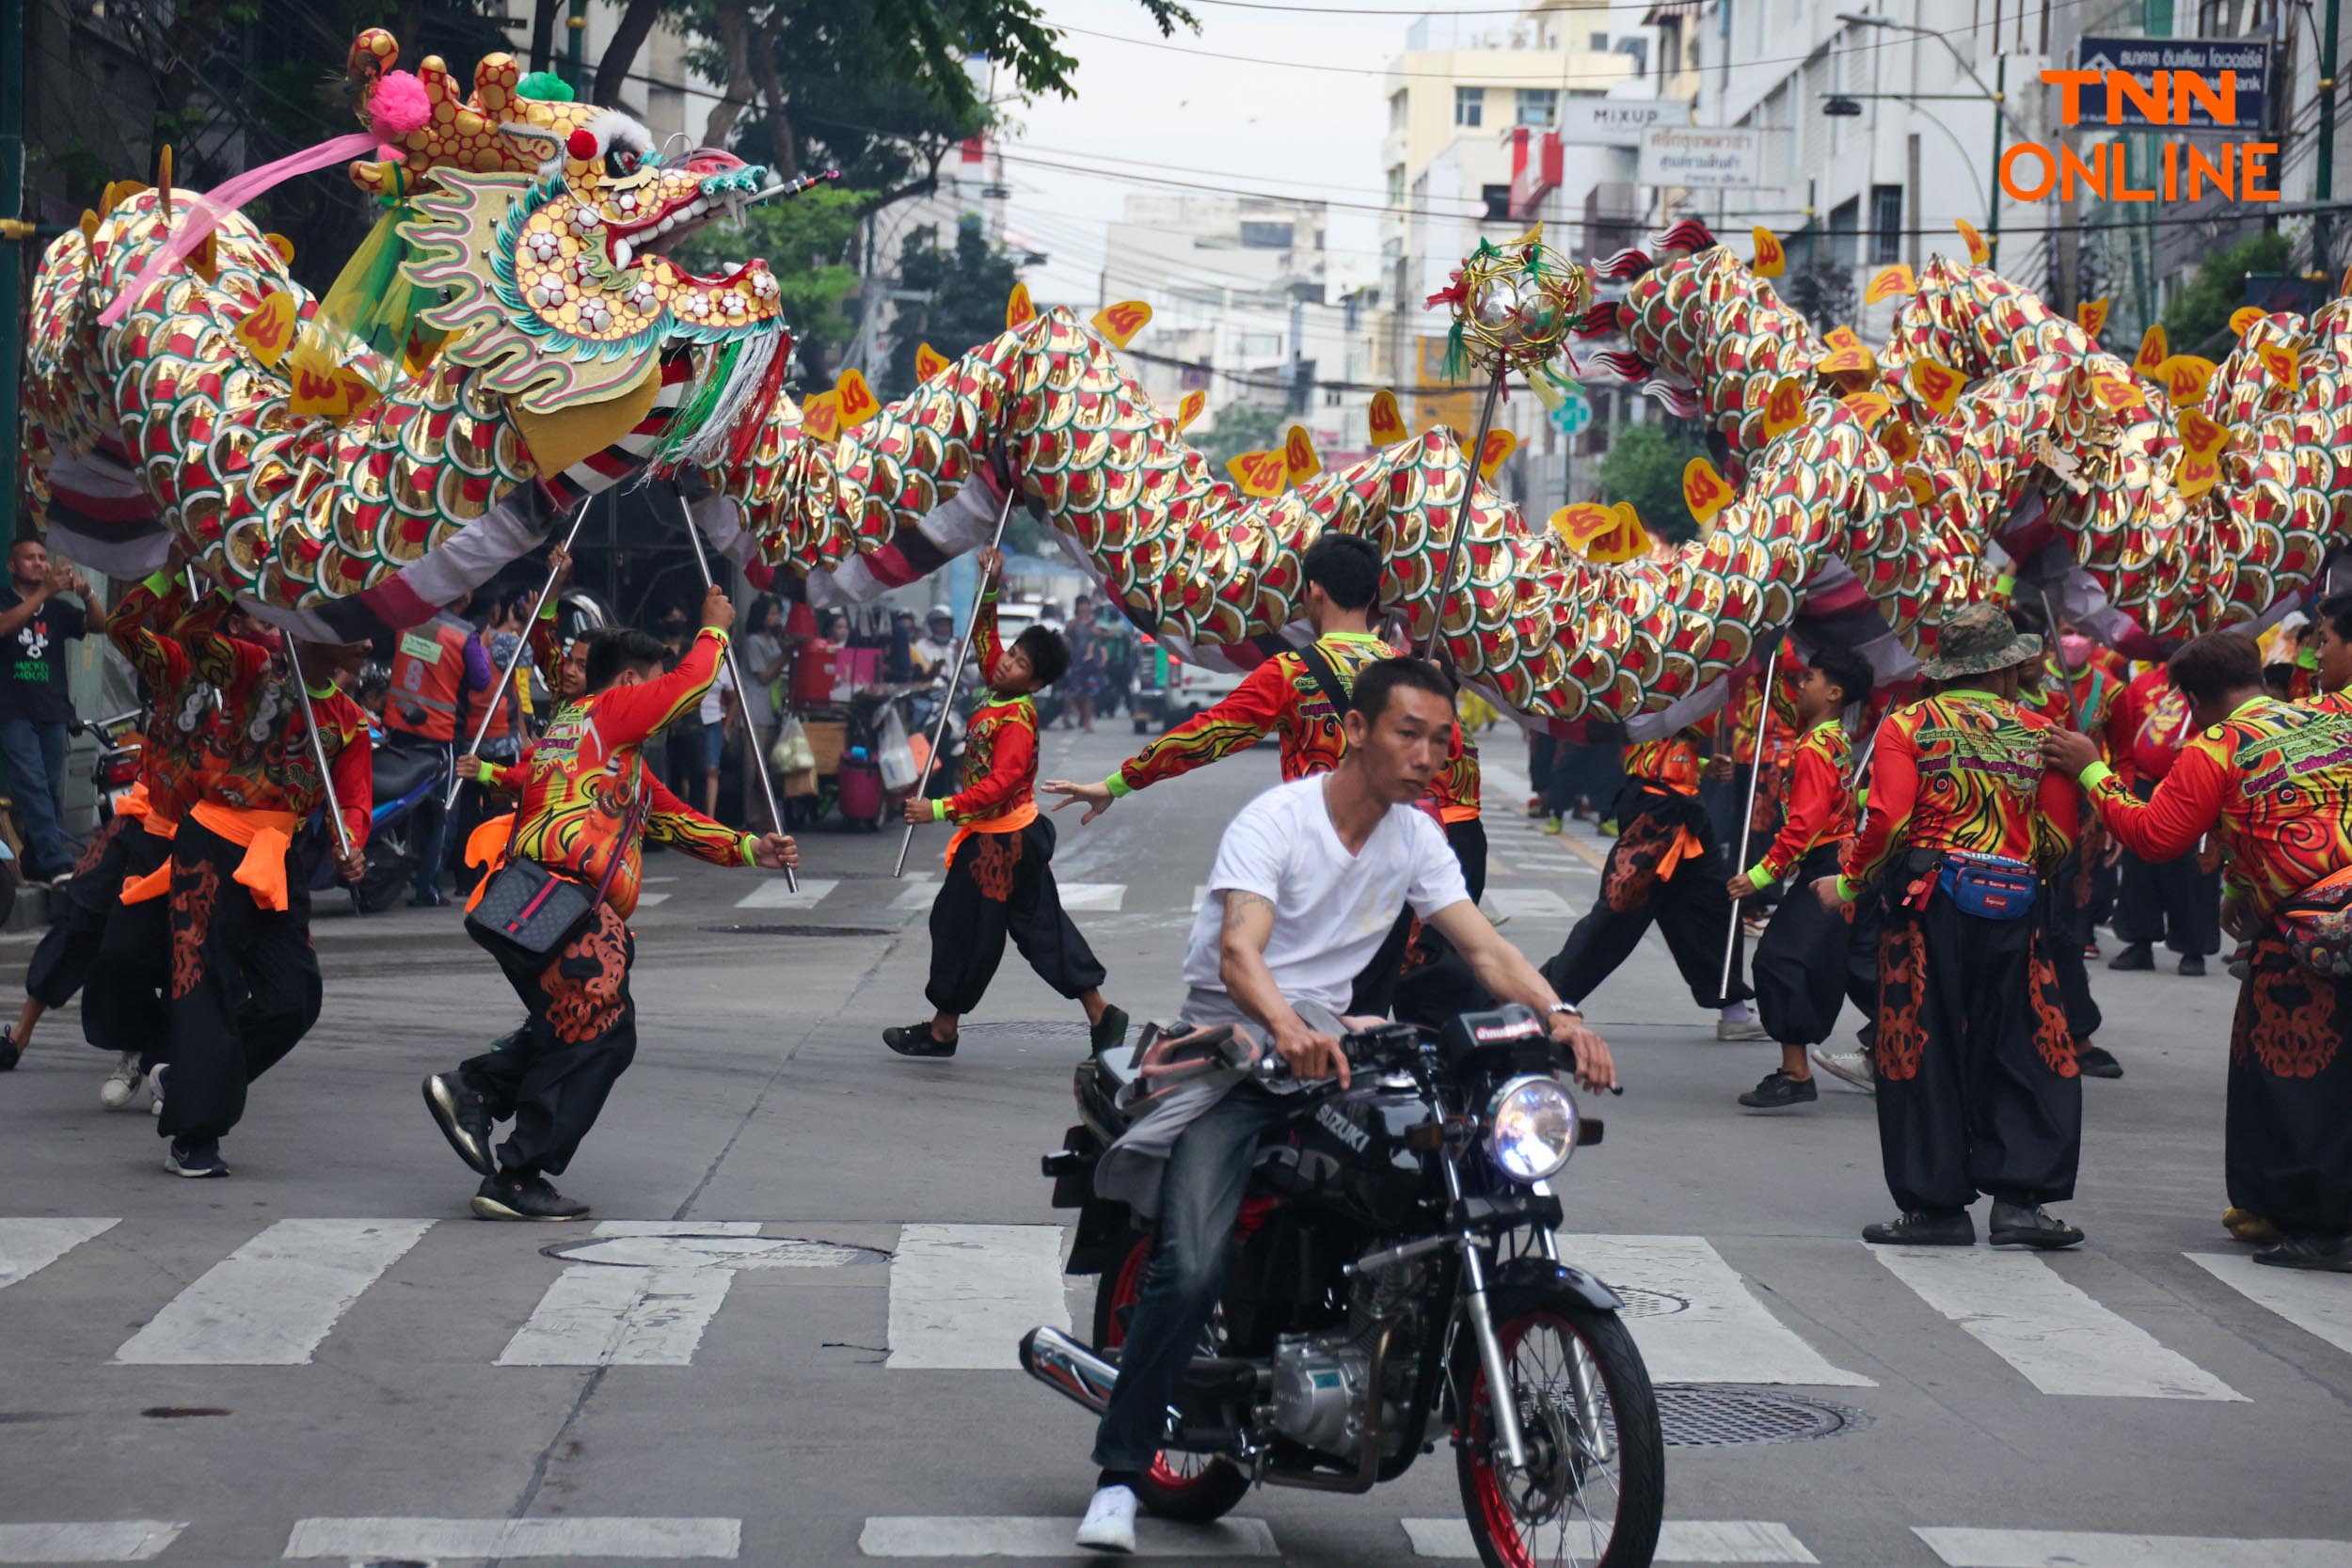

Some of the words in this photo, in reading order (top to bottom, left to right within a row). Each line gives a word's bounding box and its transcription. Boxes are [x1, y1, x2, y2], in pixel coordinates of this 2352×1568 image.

[1593, 109, 1659, 123] MIXUP
[405, 659, 424, 691] 8
[1315, 1103, 1371, 1153] SUZUKI
